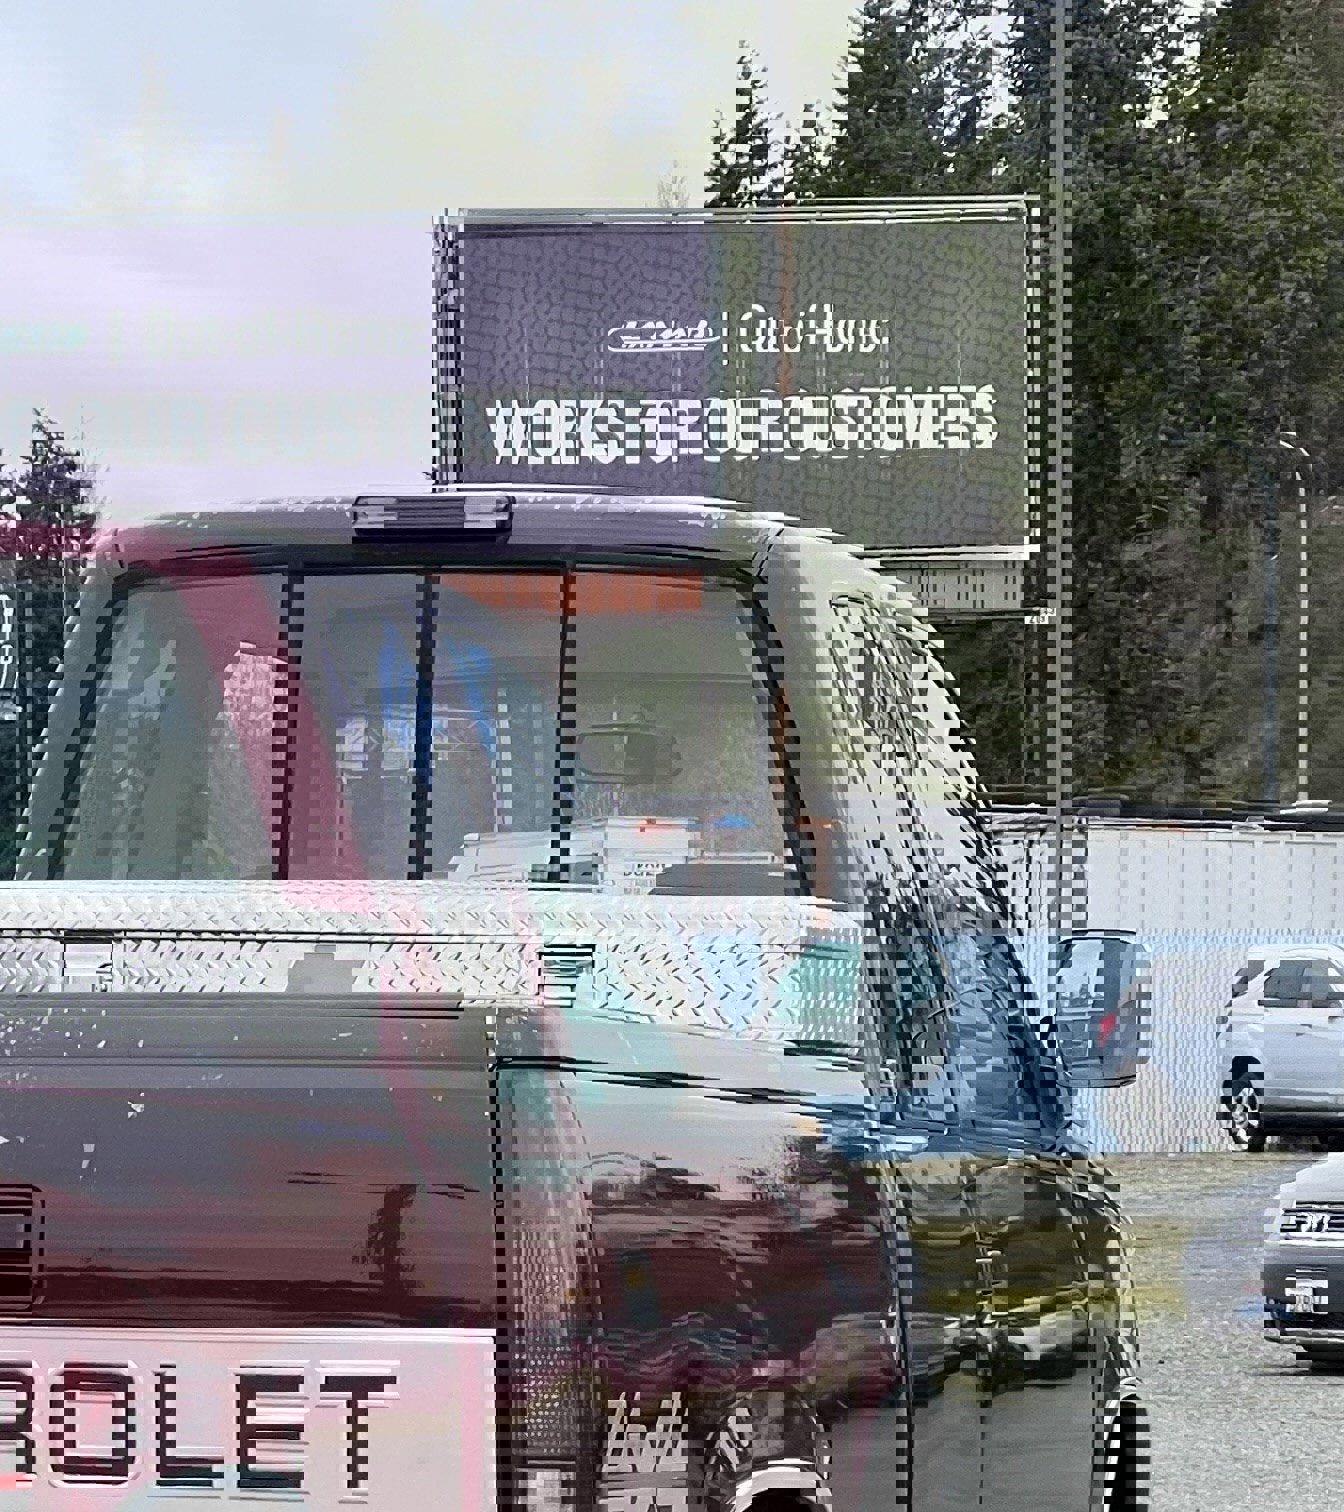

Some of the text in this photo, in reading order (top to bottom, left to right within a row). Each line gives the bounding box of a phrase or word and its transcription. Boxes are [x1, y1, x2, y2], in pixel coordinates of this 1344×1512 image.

[147, 310, 427, 355] Out-of-Home:
[68, 397, 209, 463] OUR
[229, 391, 647, 460] CUSTOMERS
